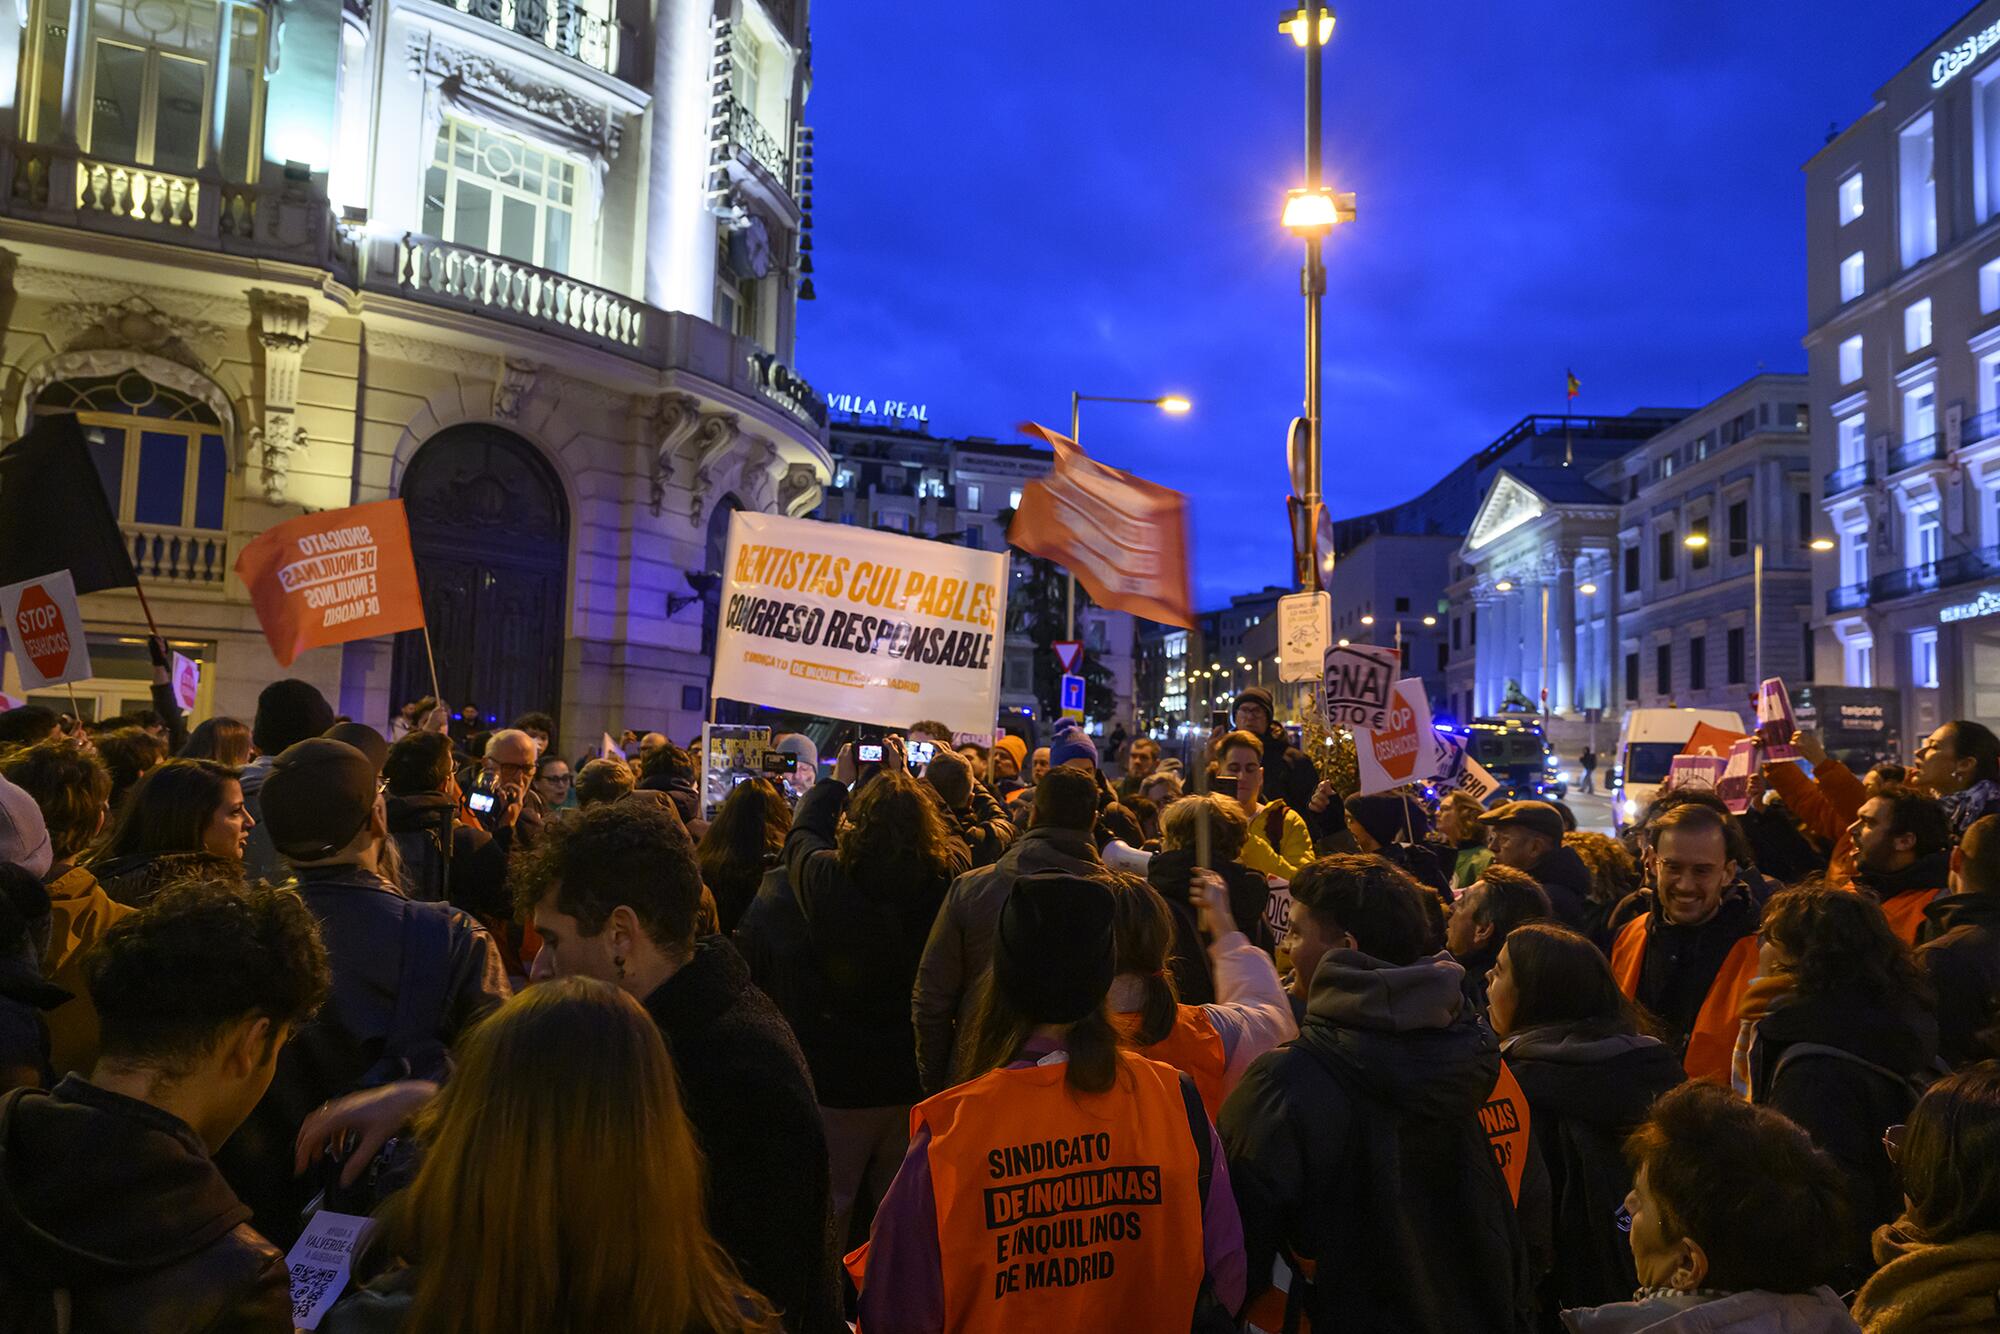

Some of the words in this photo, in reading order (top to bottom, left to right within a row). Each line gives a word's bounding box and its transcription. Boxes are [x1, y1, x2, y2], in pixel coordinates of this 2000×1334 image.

[827, 392, 877, 416] VILLA
[883, 399, 929, 422] REAL
[735, 544, 850, 598] RENTISTAS
[18, 604, 57, 634] STOP
[726, 593, 826, 645] CONGRESO
[822, 609, 993, 670] RESPONSABLE
[744, 651, 788, 670] SINDICATO
[792, 662, 807, 675] DE
[988, 1132, 1111, 1179] SINDICATO
[992, 1189, 1025, 1224] DE
[1026, 1170, 1157, 1214] INQUILINAS
[305, 1234, 348, 1252] VALVERDE
[996, 1233, 1009, 1265] E
[1012, 1212, 1142, 1257] INQUILINOS
[995, 1264, 1020, 1300] DE
[1025, 1251, 1115, 1290] MADRID
